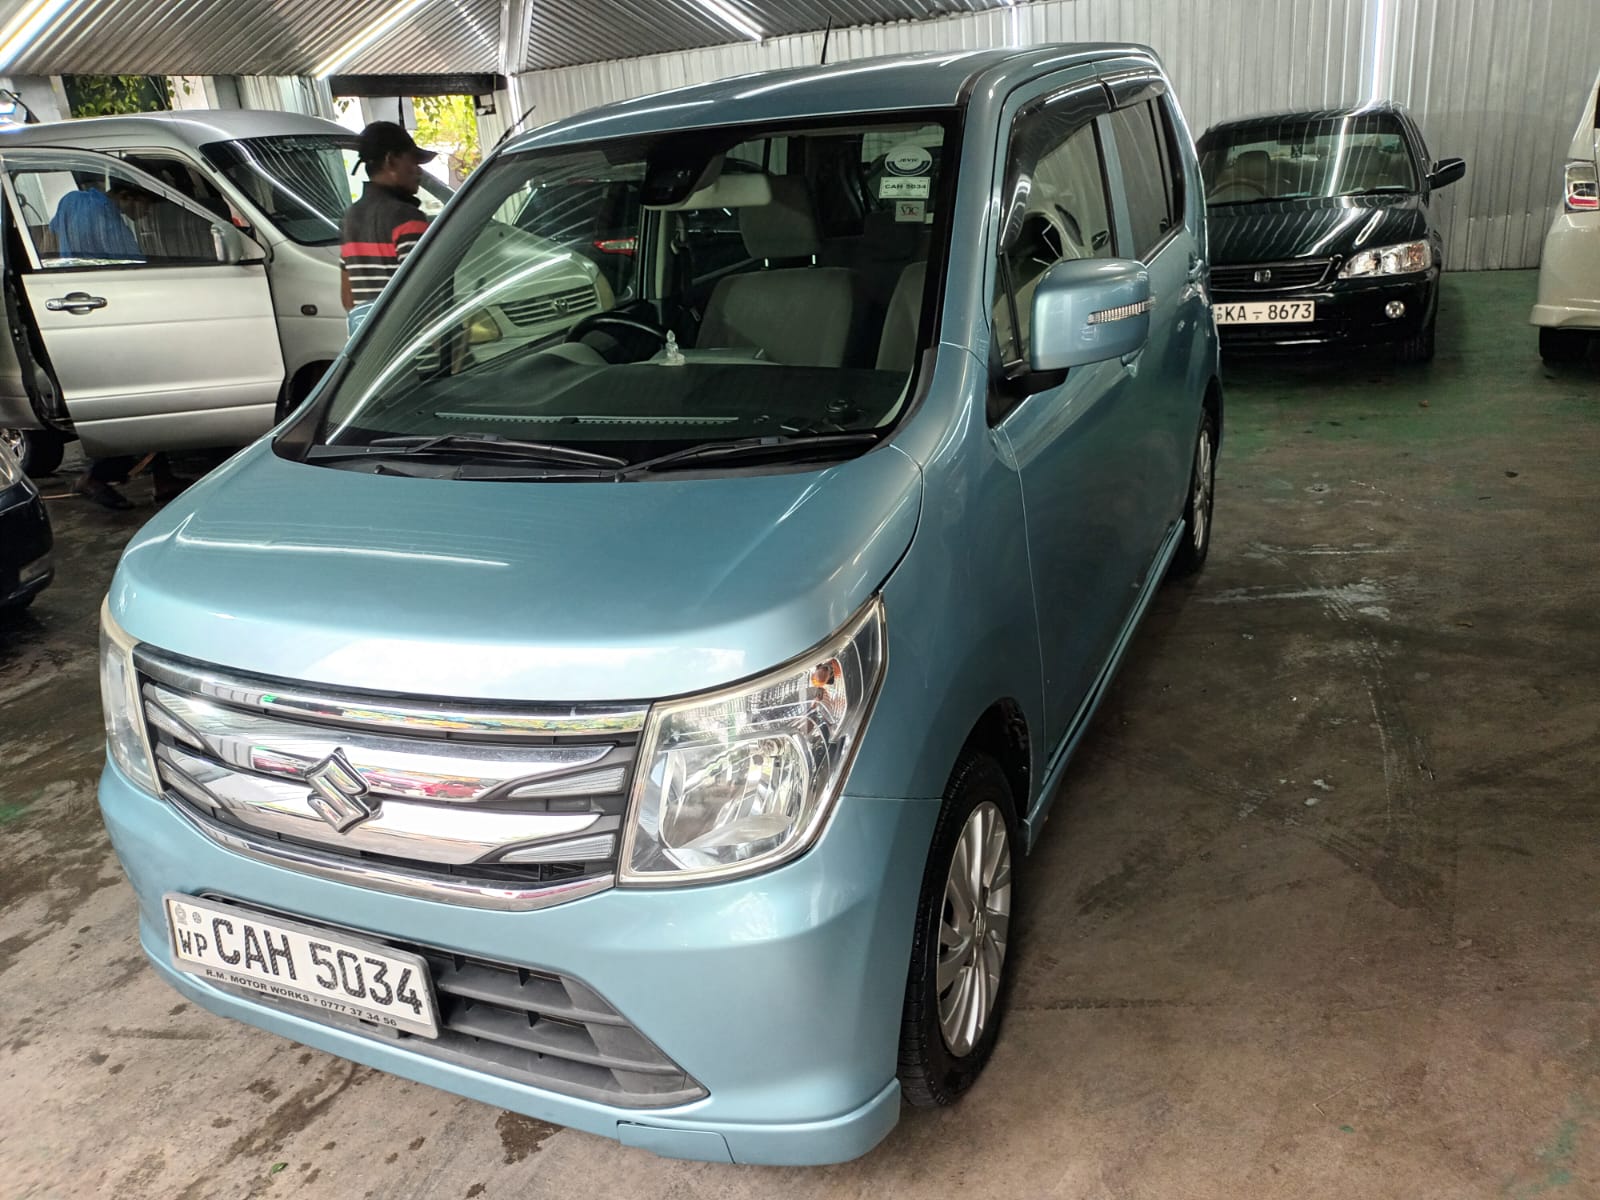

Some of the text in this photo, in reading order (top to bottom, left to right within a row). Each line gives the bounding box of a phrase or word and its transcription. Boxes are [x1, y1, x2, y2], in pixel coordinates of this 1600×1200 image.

[1225, 305, 1247, 321] KA
[1268, 303, 1312, 320] 8673
[178, 917, 423, 1015] WP CAH 5034
[206, 968, 228, 981] R.M.
[230, 974, 267, 991] MOTOR
[270, 984, 310, 1002] WORKS
[320, 999, 347, 1012] 0777
[350, 1007, 362, 1016] 37
[366, 1012, 380, 1022] 34
